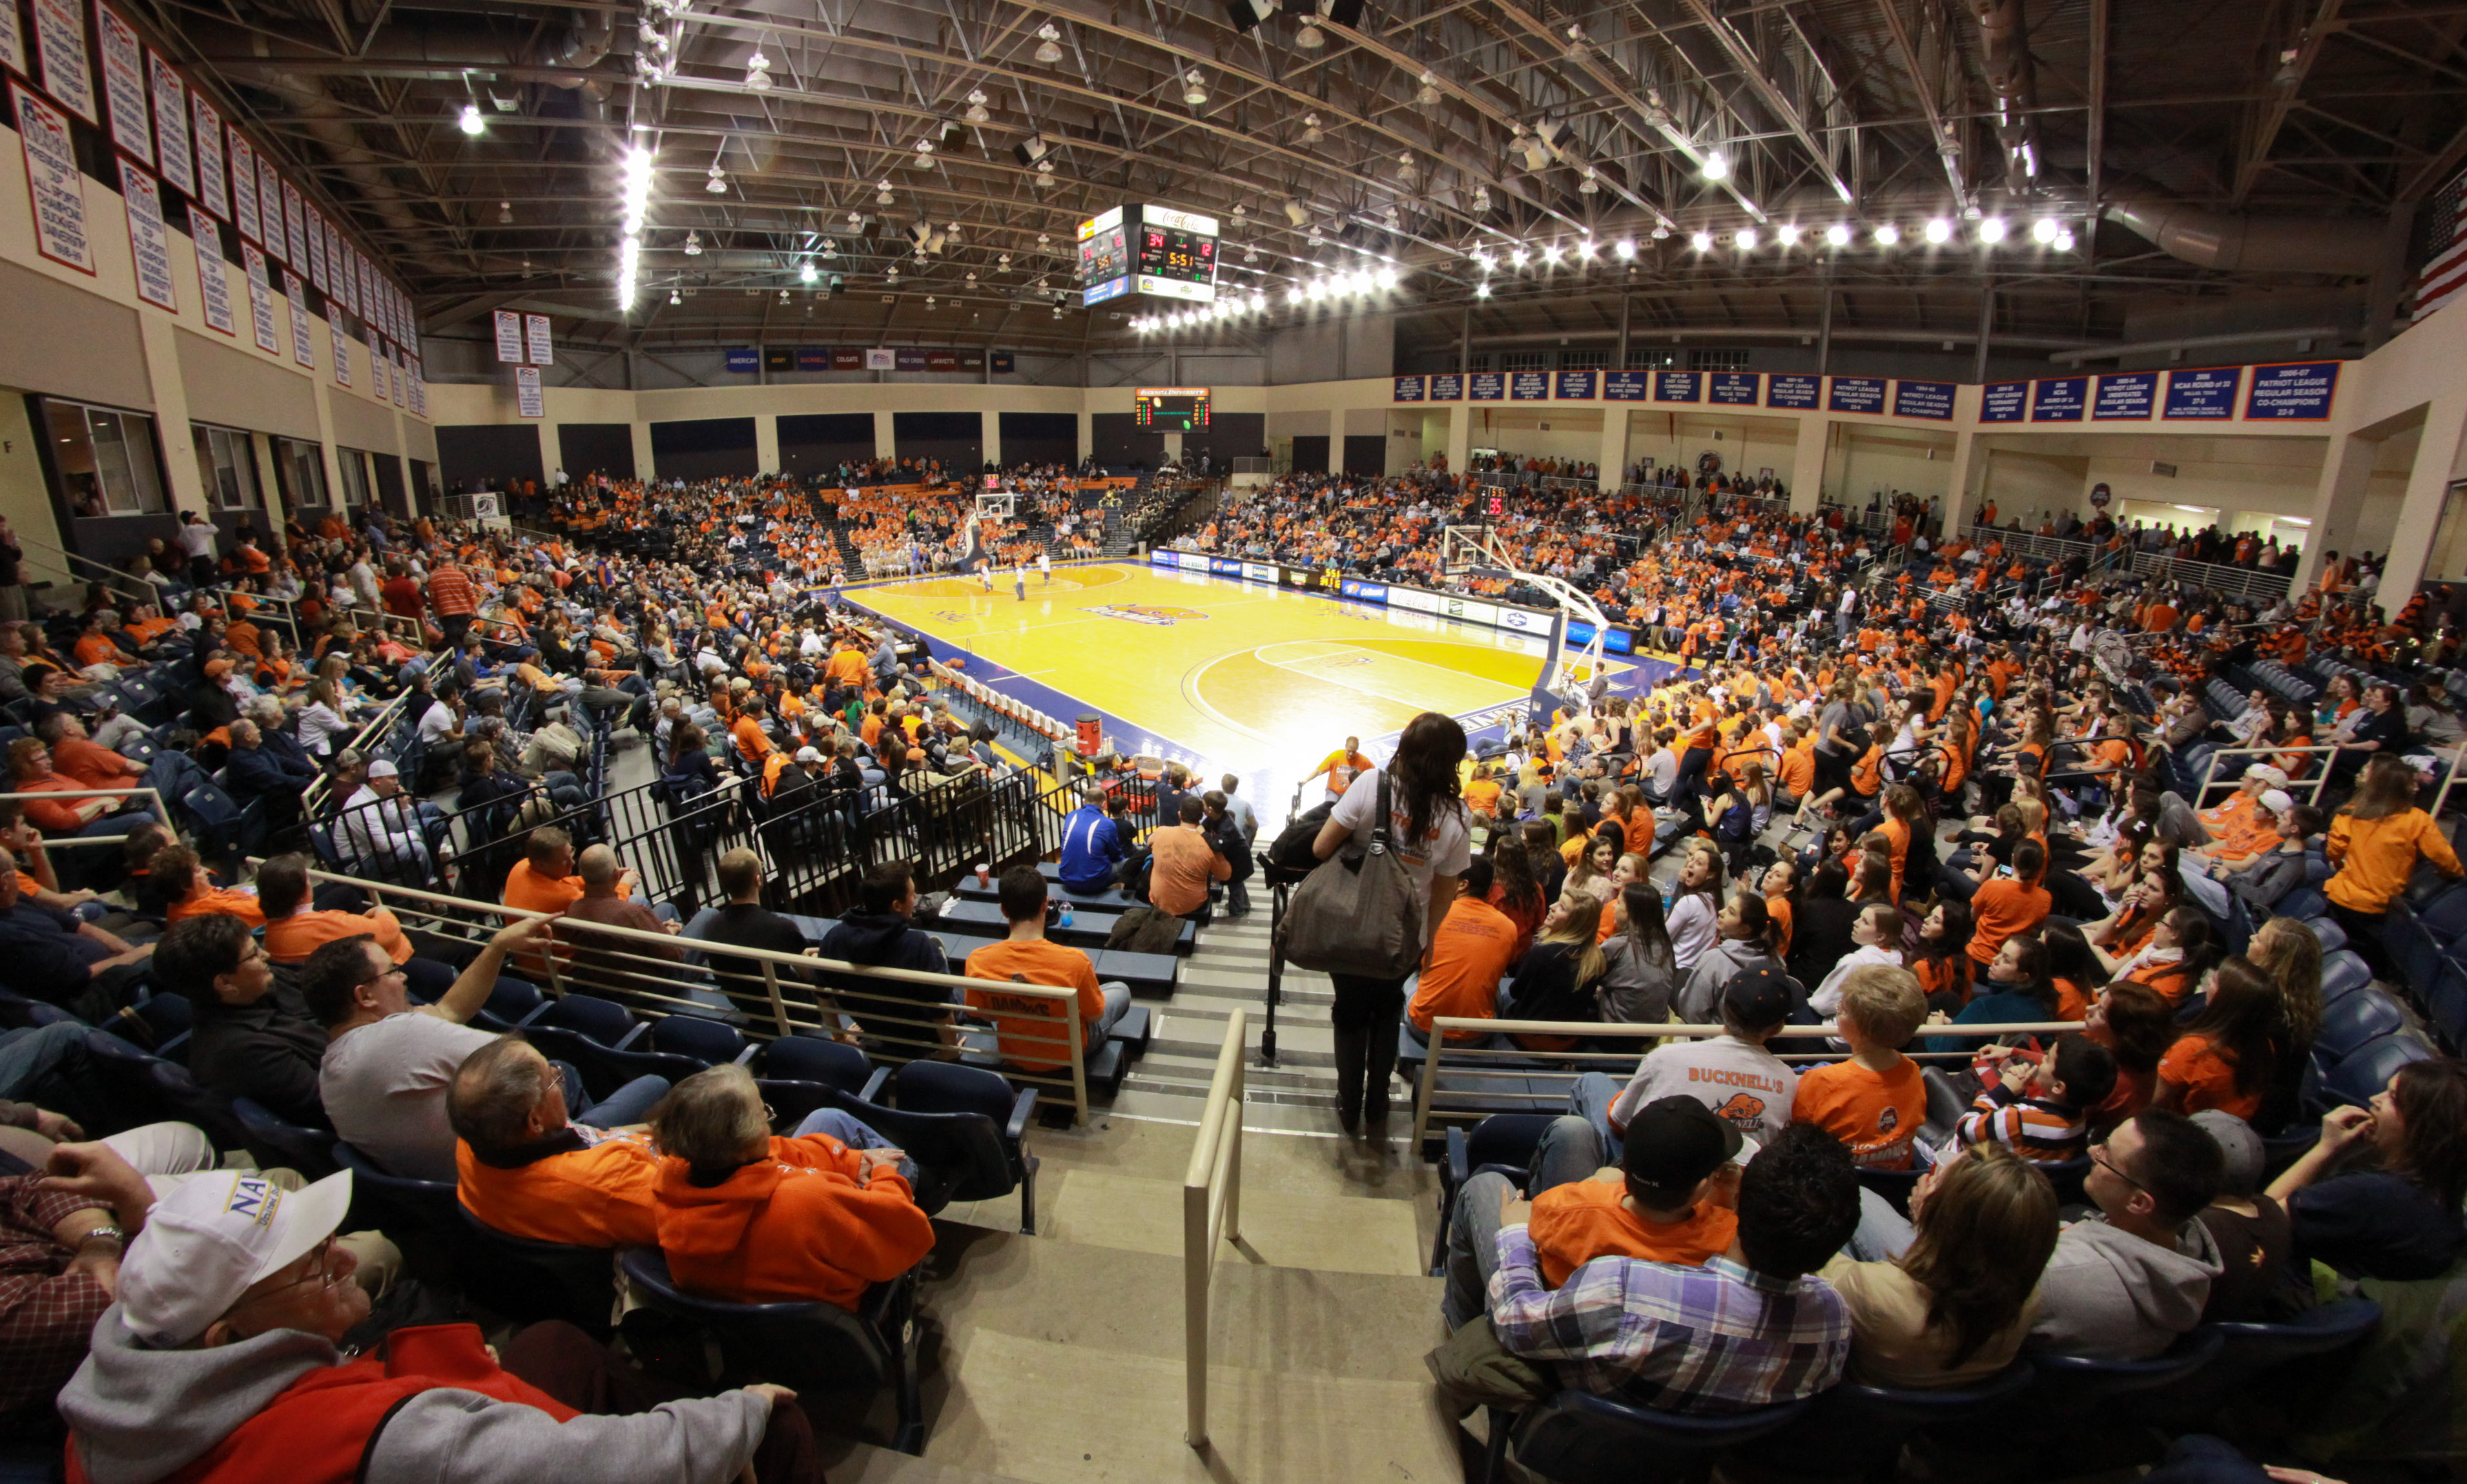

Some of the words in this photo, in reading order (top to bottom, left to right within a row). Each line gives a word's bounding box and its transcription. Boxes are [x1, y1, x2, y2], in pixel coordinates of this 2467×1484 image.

[32, 174, 50, 194] ALL
[50, 183, 81, 210] SPORTS
[41, 207, 83, 236] BUCKNELL
[1163, 211, 1199, 231] Coca-Cola
[42, 222, 87, 252] UNIVERSITY
[1144, 226, 1167, 236] BUCKNELL
[1149, 233, 1164, 247] 34
[1201, 243, 1213, 256] 12
[1170, 252, 1193, 267] 5:51
[2278, 369, 2311, 377] 2006-07
[2258, 379, 2293, 387] PATRIOT
[2293, 378, 2328, 386] LEAGUE
[2256, 398, 2321, 406] CO-CHAMPIONS
[1901, 407, 1945, 416] CO-CHAMPIONS
[987, 479, 998, 488] 35
[1489, 497, 1503, 515] 35
[1688, 1067, 1784, 1094] BUCKNELL'S
[258, 1198, 277, 1226] United
